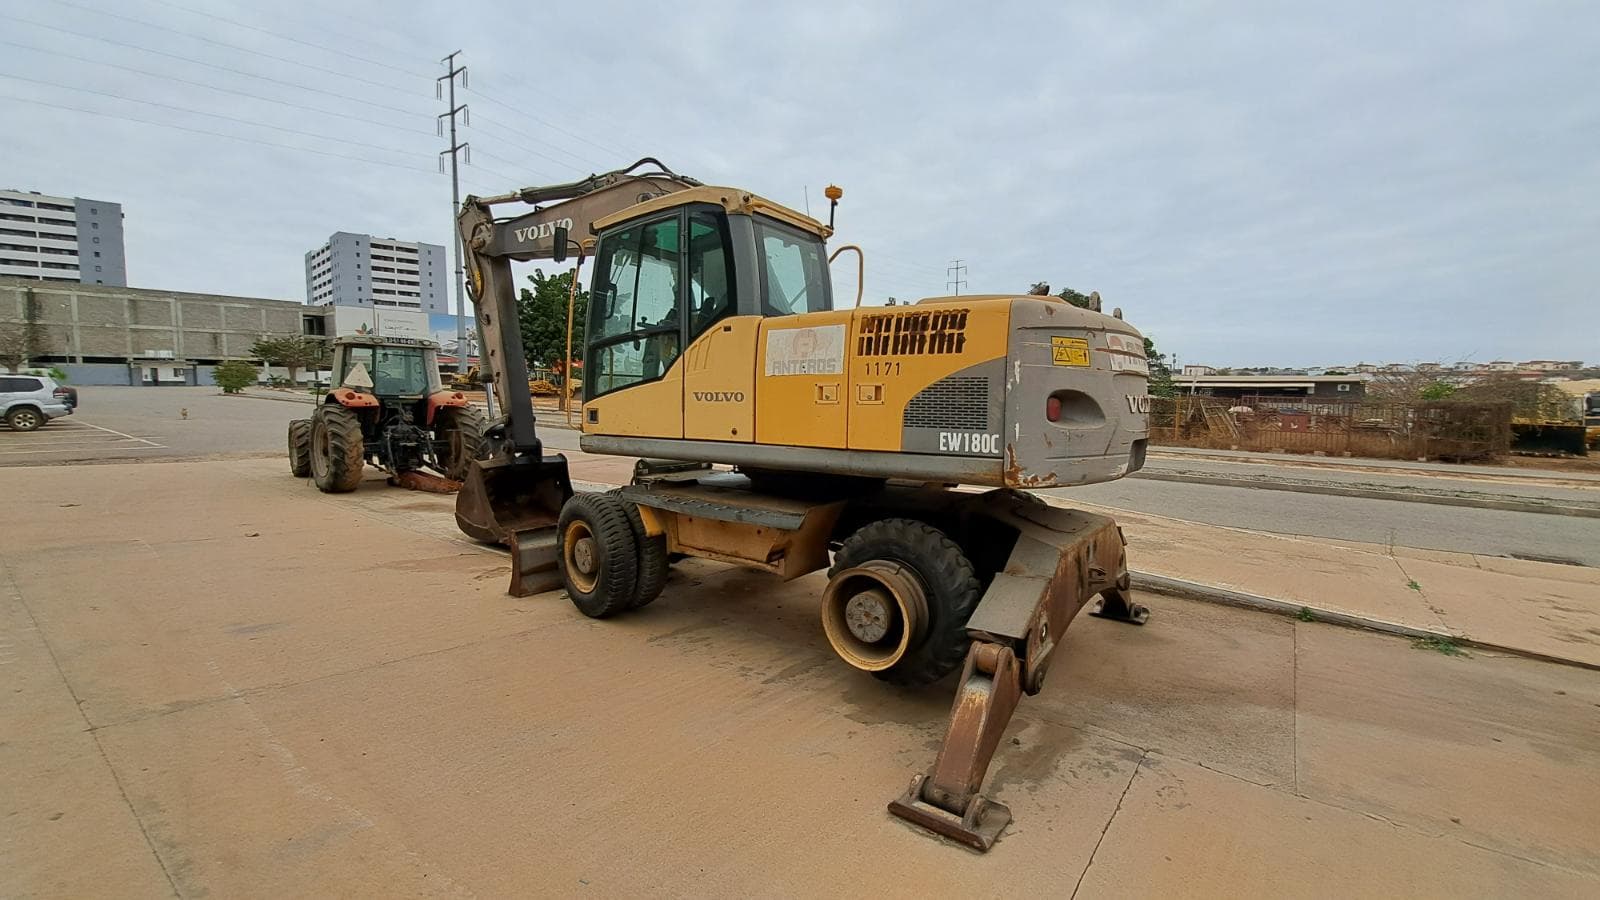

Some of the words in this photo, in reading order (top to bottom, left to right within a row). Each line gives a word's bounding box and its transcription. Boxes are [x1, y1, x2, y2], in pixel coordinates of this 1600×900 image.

[514, 217, 573, 243] VOLVO
[865, 362, 901, 376] 1171
[693, 391, 745, 402] VOLVO
[939, 432, 999, 454] EW180C
